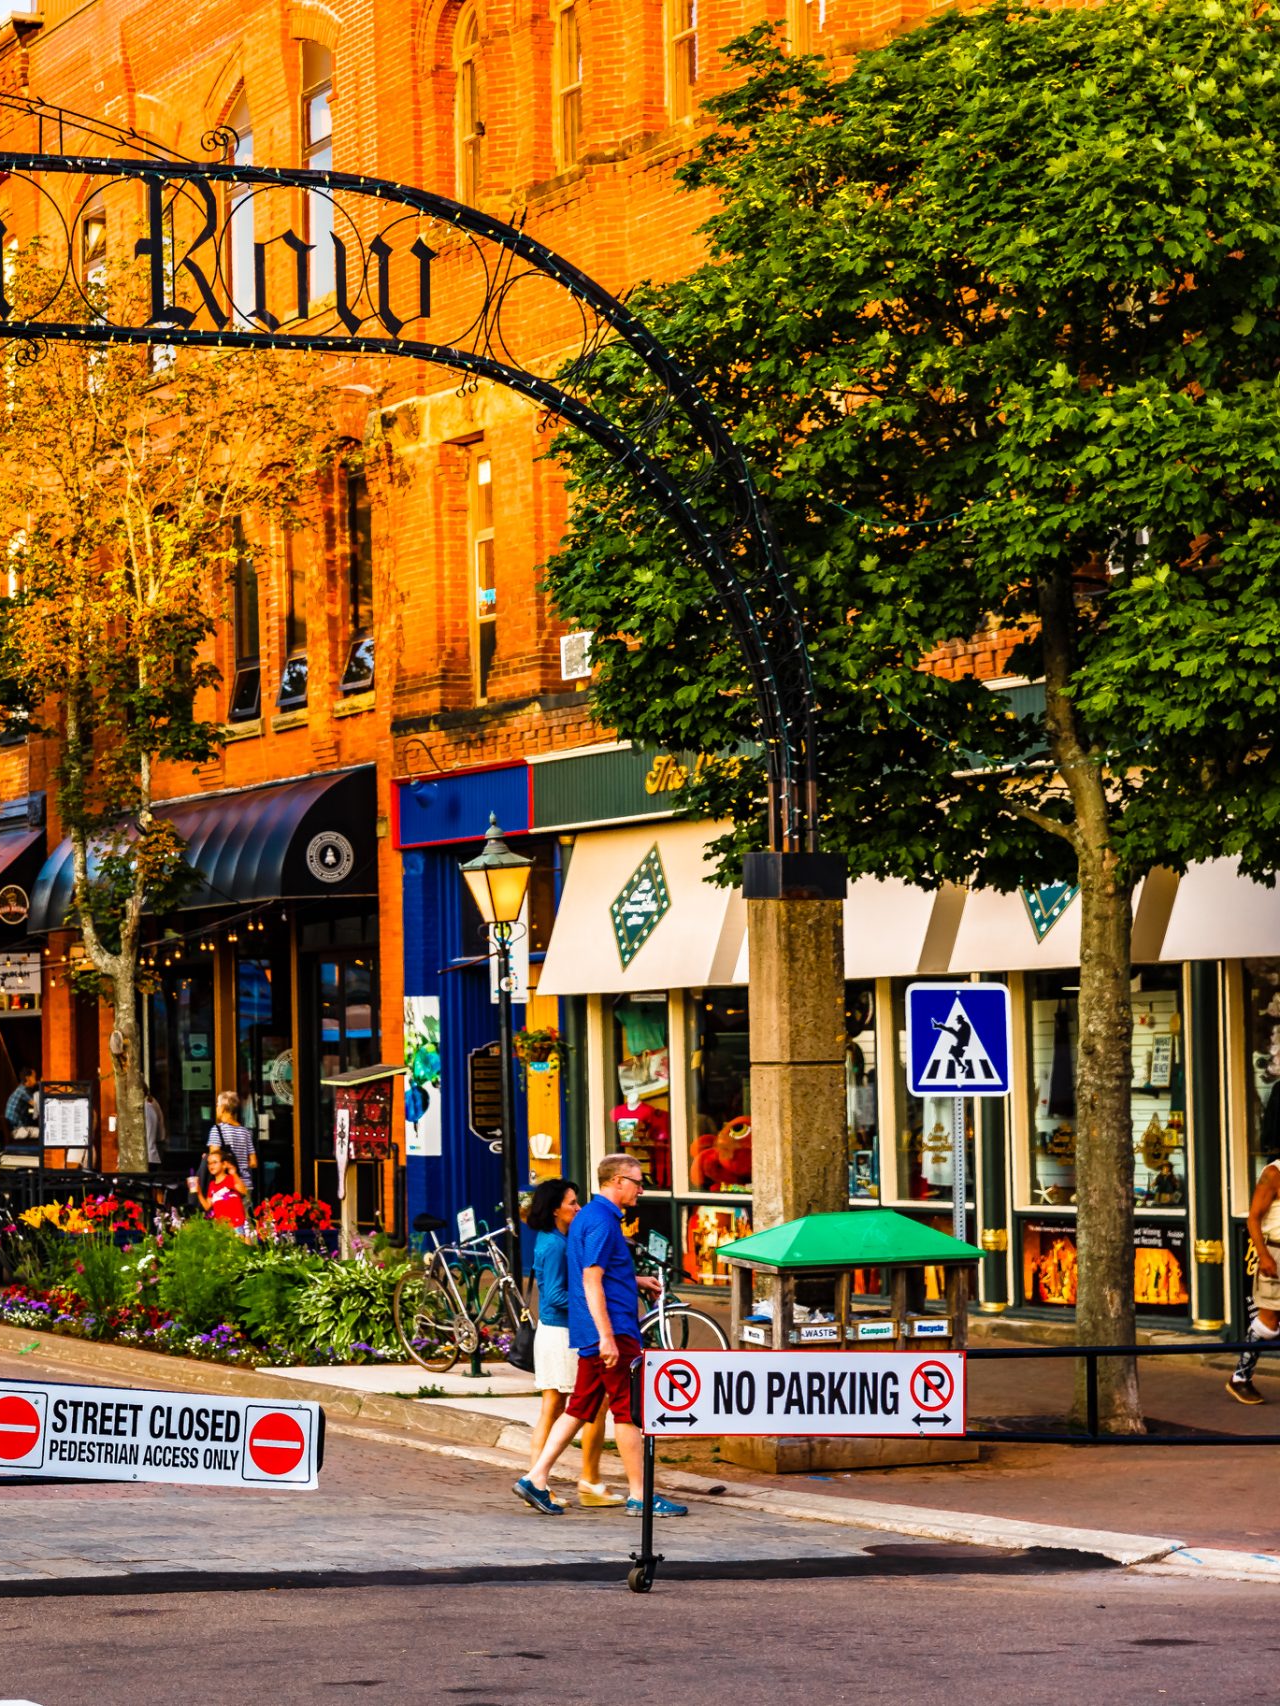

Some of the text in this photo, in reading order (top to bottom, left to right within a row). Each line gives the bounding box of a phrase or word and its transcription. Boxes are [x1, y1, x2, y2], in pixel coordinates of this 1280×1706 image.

[135, 173, 438, 337] Row
[645, 754, 688, 795] The
[713, 1371, 899, 1415] NO PARKING
[52, 1399, 240, 1443] STREET CLOSED
[49, 1439, 240, 1471] PEDESTRIAN ACCESS ONLY
